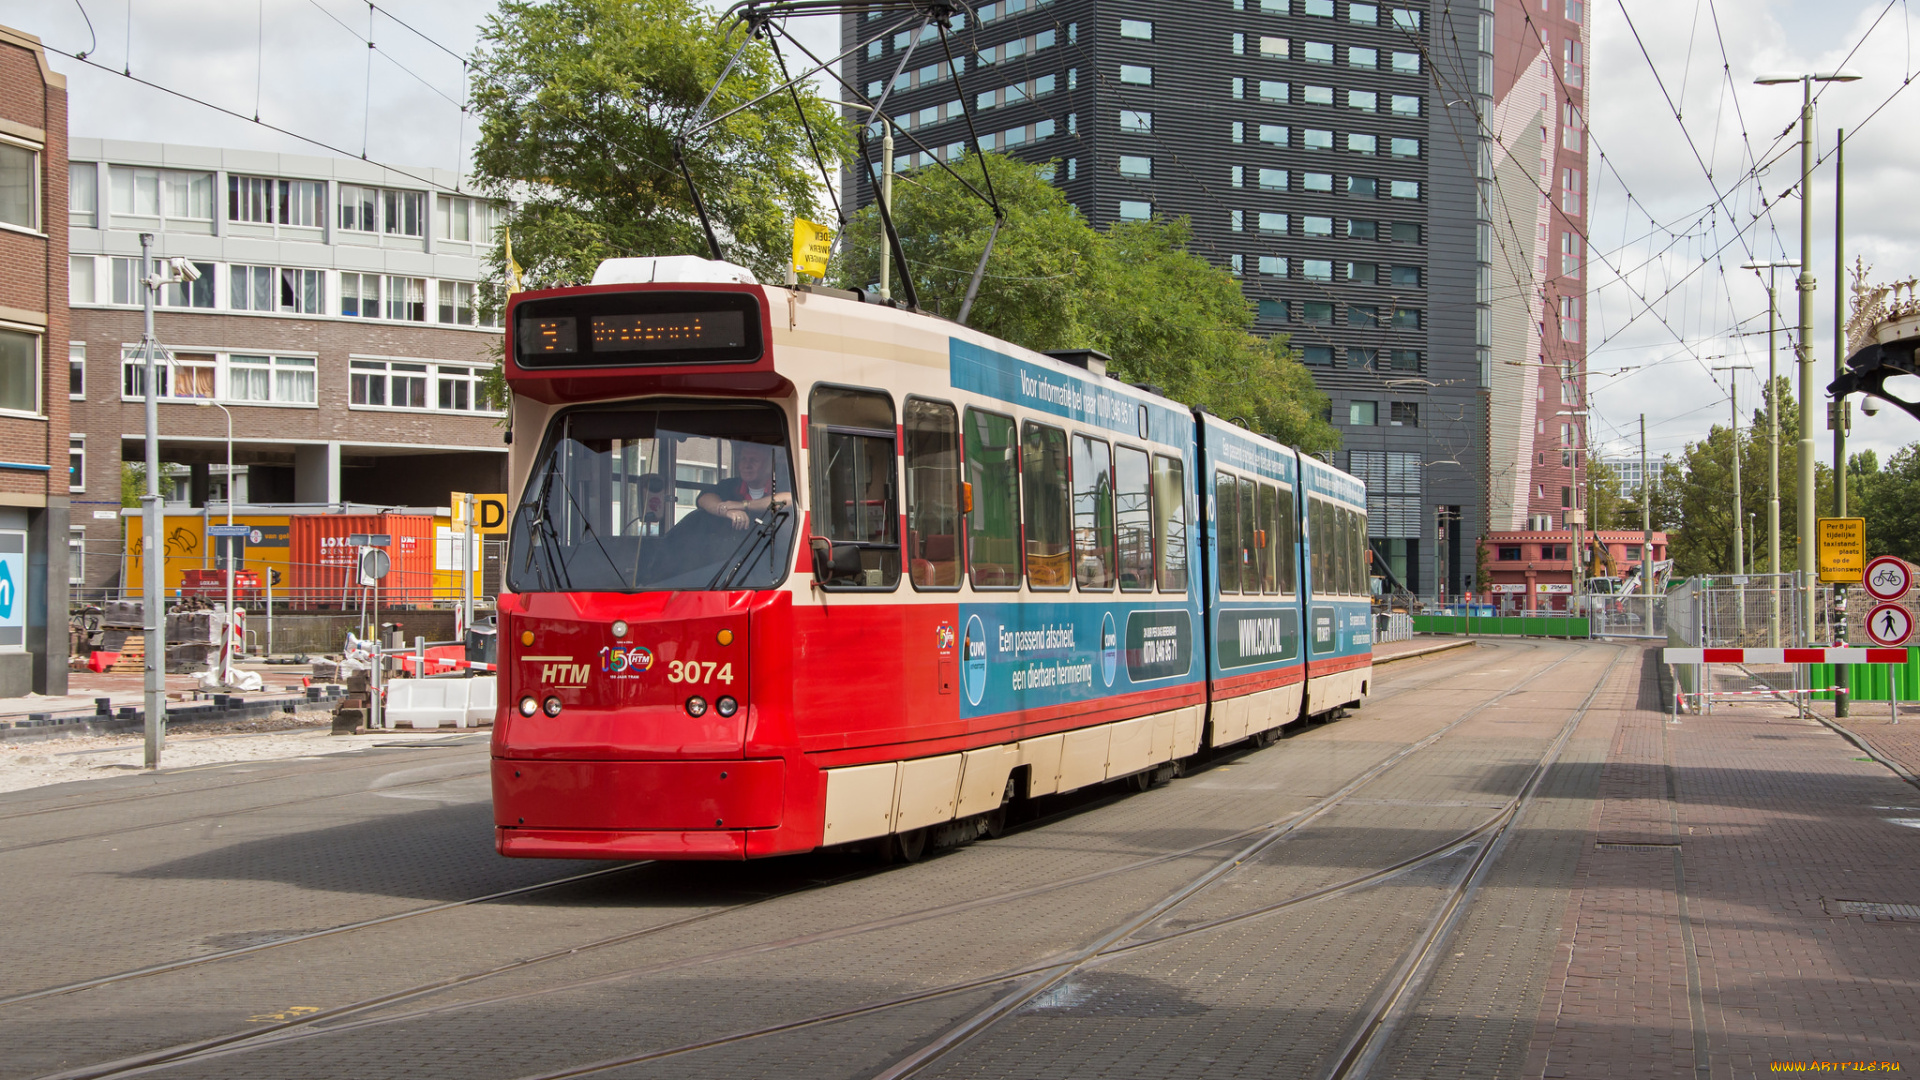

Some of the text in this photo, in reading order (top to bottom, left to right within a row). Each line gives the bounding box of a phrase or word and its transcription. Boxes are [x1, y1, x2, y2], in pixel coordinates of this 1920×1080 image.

[1020, 368, 1038, 398] Voor
[1038, 374, 1072, 408] informatie
[1072, 384, 1083, 411] bel
[480, 499, 505, 528] D
[1845, 523, 1857, 531] juli
[320, 537, 351, 548] LOXA
[998, 622, 1076, 658] Een passend afscheid,
[1238, 617, 1283, 658] WWW.CUVO.NL
[631, 655, 650, 663] HTM
[667, 659, 735, 686] 3074
[540, 663, 591, 685] HTM
[1012, 657, 1092, 691] een dierbare herinnering
